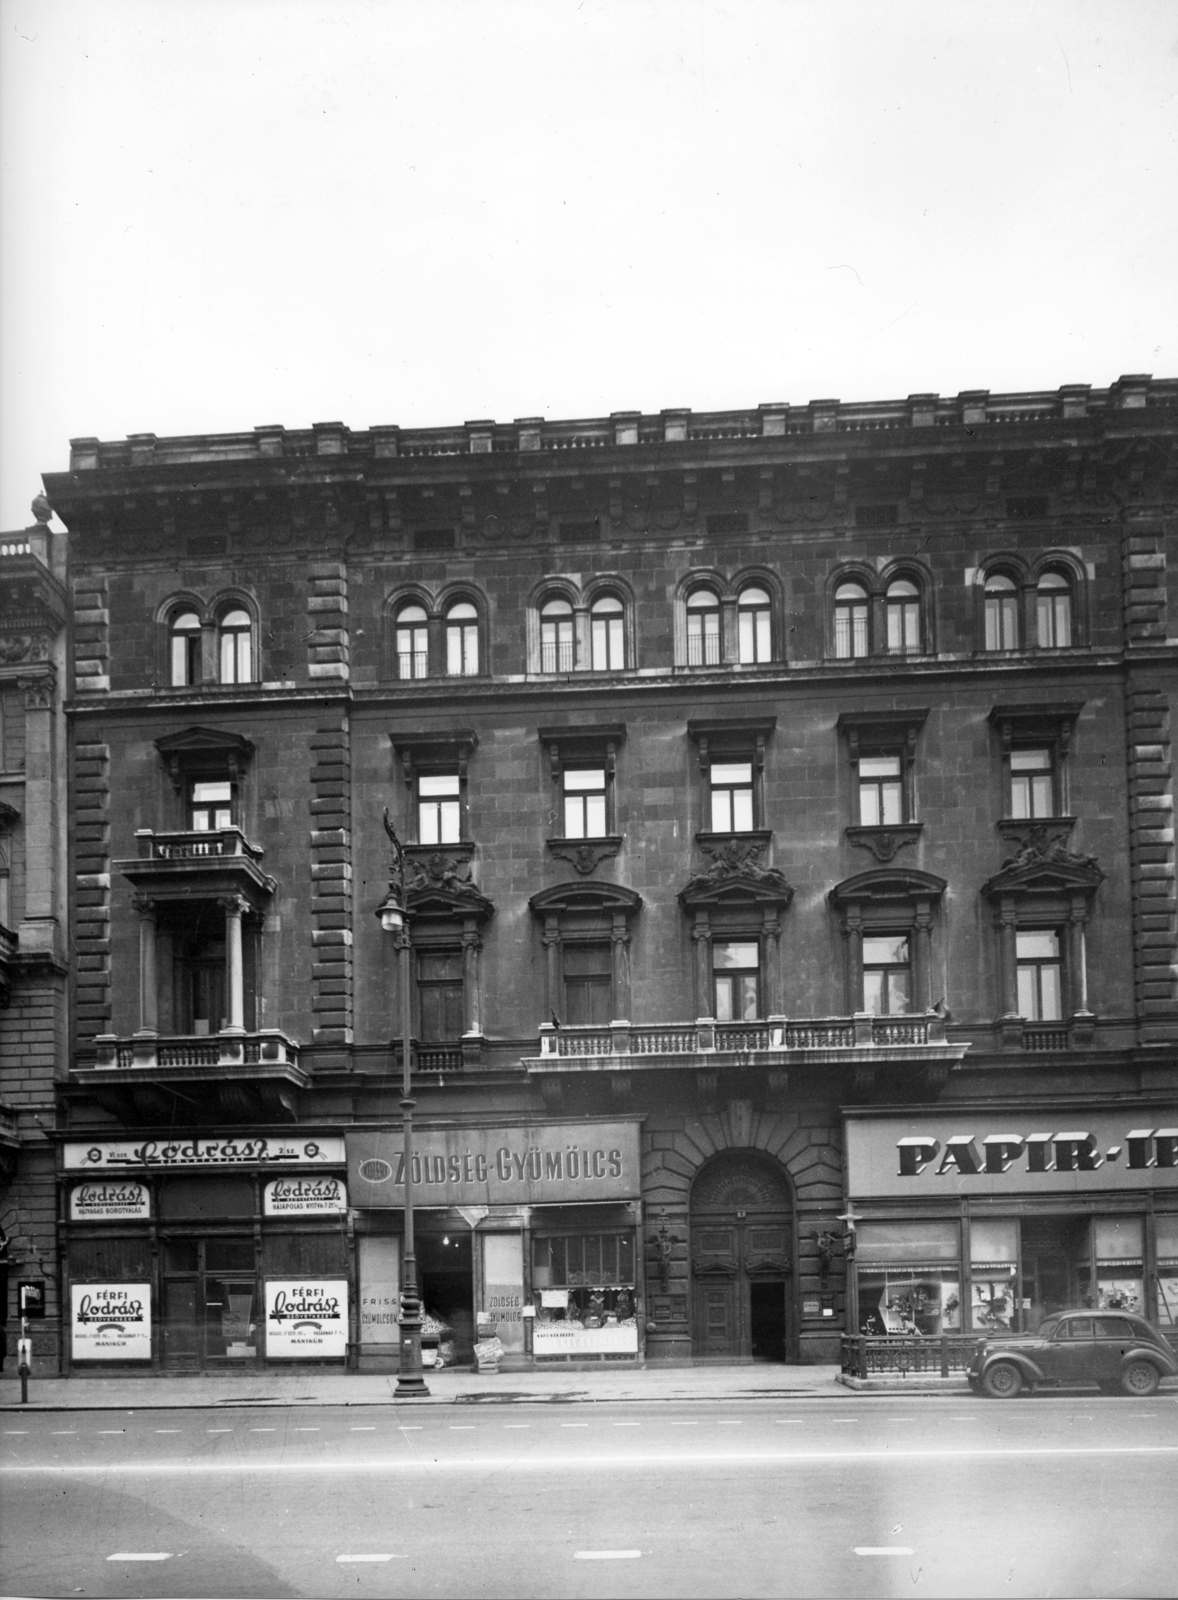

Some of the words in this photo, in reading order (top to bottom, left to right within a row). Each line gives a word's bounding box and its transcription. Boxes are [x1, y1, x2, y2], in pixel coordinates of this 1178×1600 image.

[96, 1289, 128, 1300] FÉRFI
[292, 1286, 324, 1297] FÉRFI
[363, 1298, 397, 1306] FRISS
